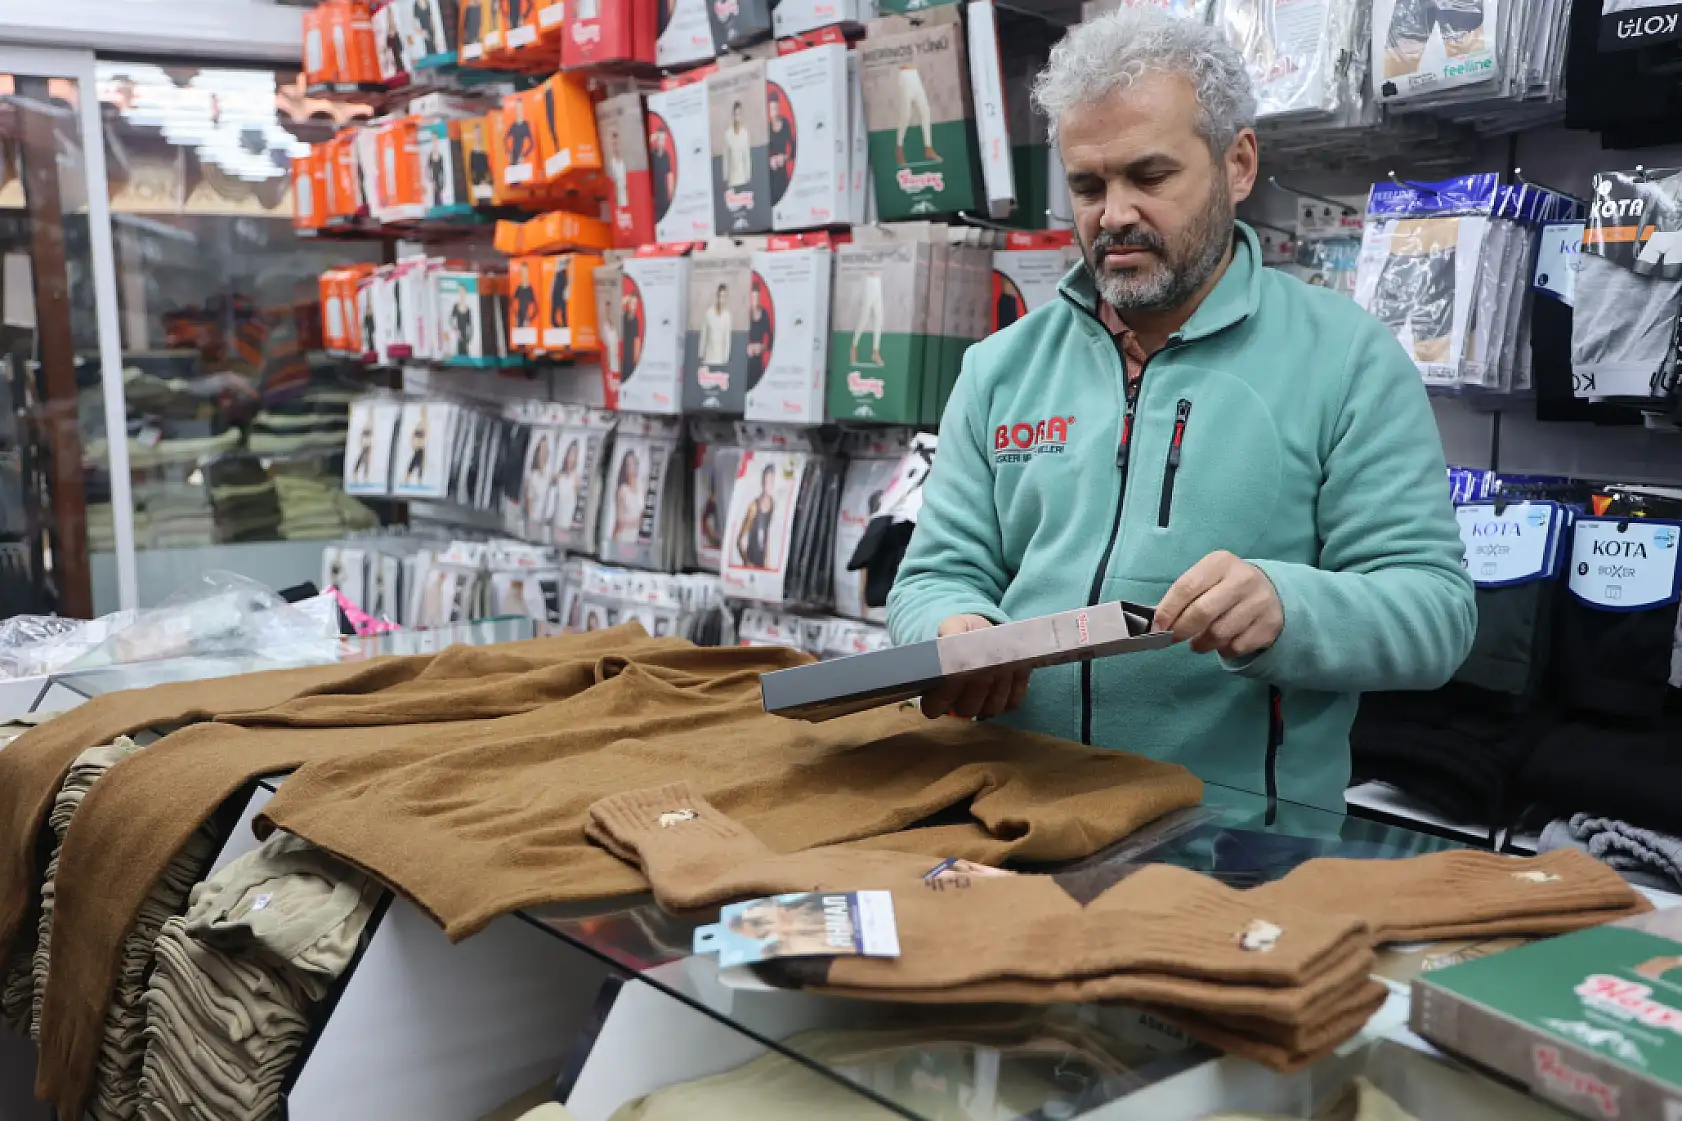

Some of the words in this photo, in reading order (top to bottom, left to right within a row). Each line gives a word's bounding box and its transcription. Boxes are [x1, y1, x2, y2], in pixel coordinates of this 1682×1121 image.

[1589, 198, 1644, 219] KOTA
[1593, 540, 1647, 559] KOTA
[1598, 564, 1636, 579] BOXER
